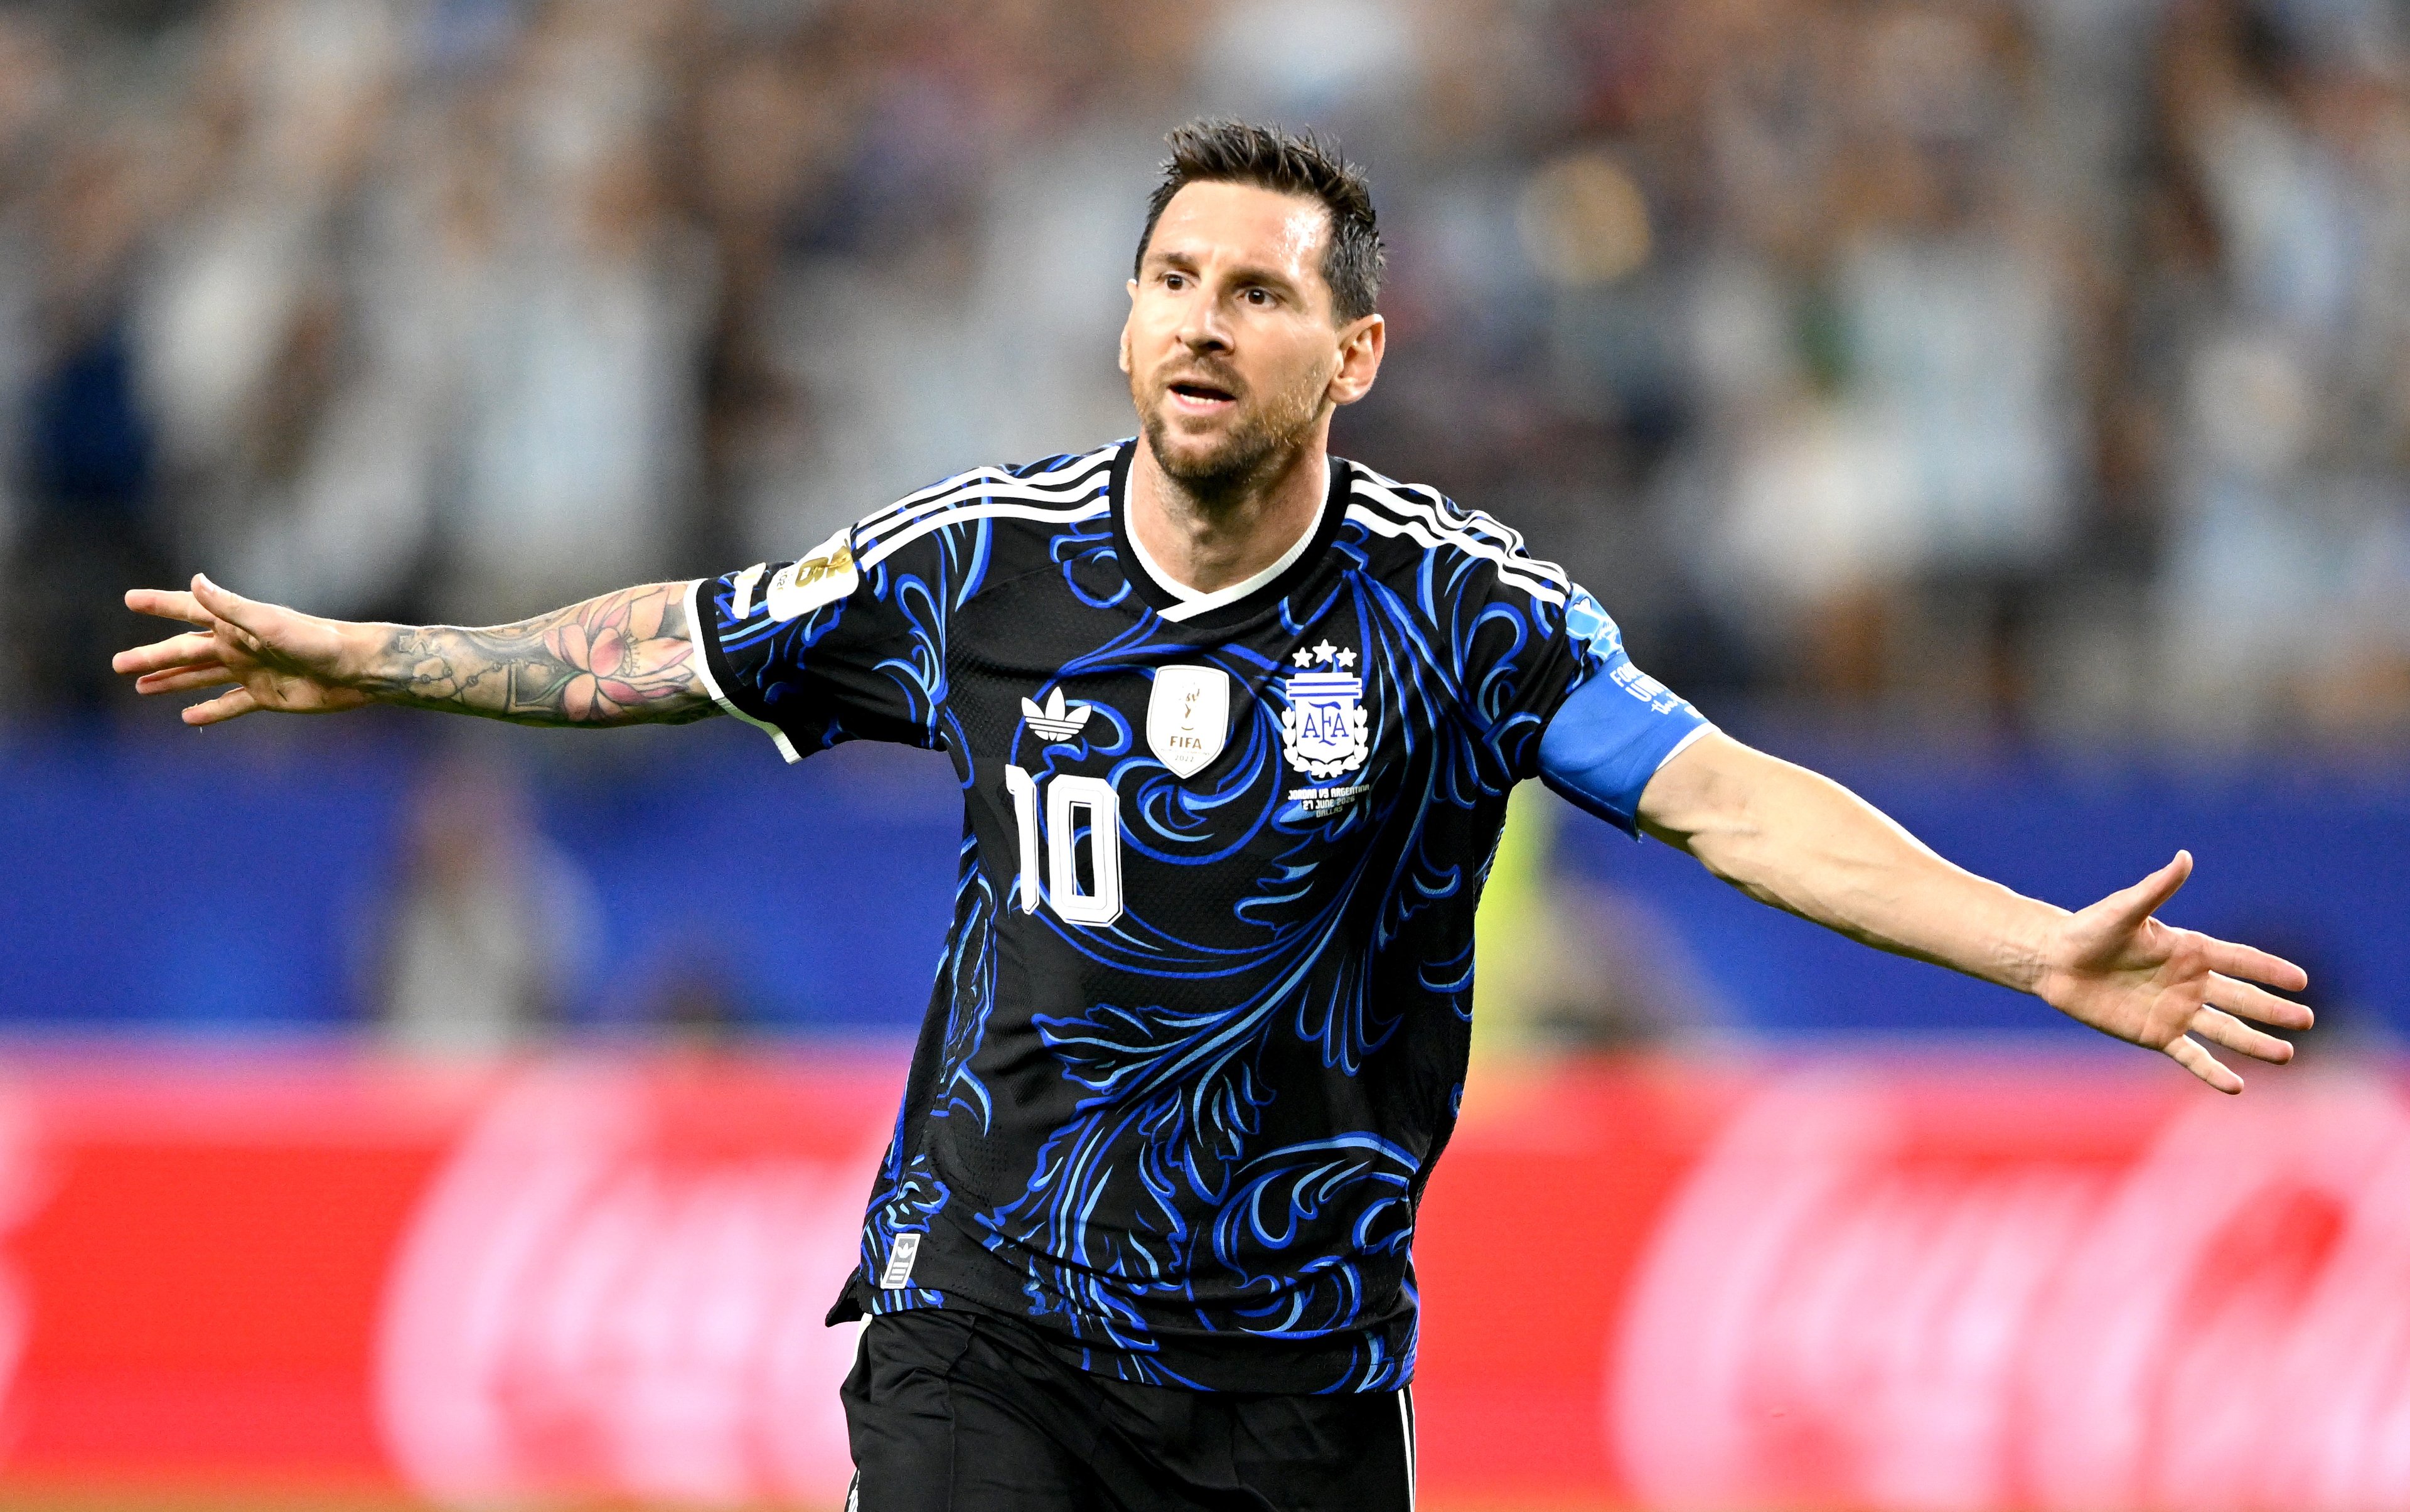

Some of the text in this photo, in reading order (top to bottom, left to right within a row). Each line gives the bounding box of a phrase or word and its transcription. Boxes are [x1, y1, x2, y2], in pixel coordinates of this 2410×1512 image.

[1301, 701, 1349, 746] AFA
[1170, 736, 1201, 749] FIFA
[1288, 784, 1369, 800] JORDAN VS ARGENTINA
[1302, 800, 1314, 810] 27
[1315, 798, 1334, 809] JUNE
[1316, 805, 1343, 818] DALLAS
[1005, 764, 1123, 928] 10
